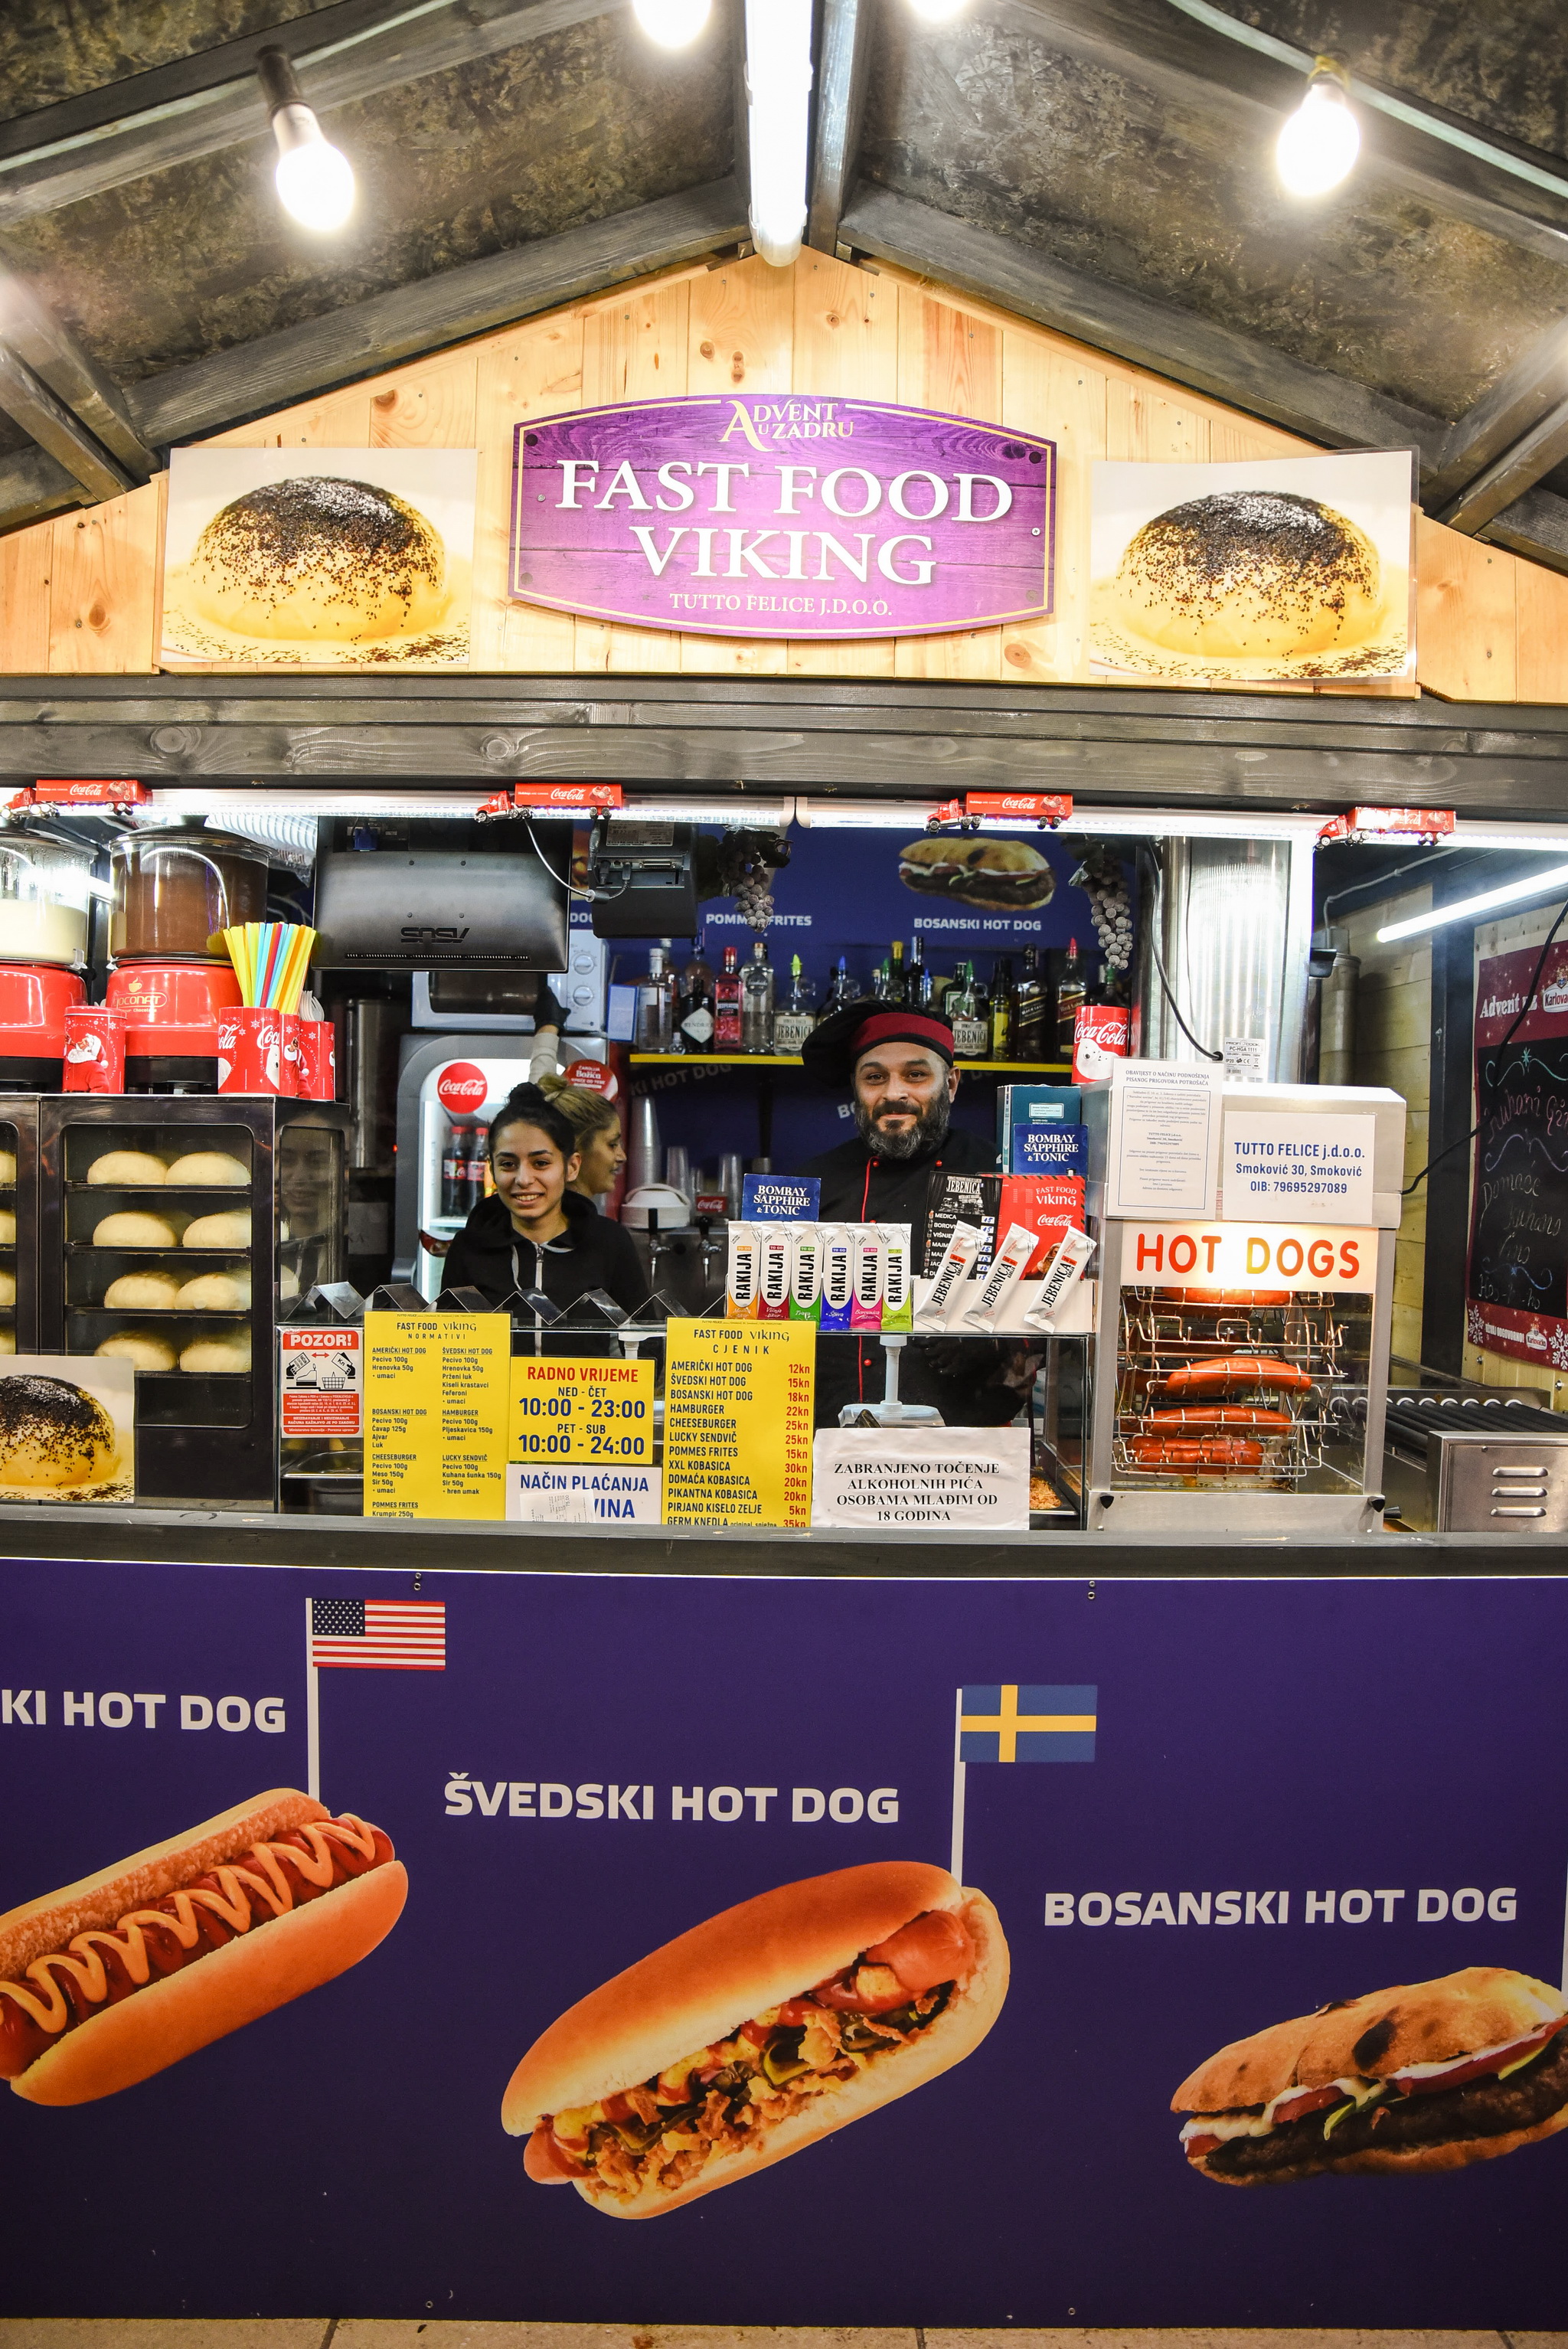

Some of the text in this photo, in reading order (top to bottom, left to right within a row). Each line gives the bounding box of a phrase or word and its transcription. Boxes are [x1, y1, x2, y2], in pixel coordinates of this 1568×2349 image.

[772, 422, 854, 439] ZADRU
[554, 459, 1013, 523] FAST FOOD
[629, 526, 937, 586] VIKING
[670, 593, 893, 616] TUTTO FELICE J.D.O.O.
[768, 915, 812, 926] FRITES
[914, 918, 1041, 931] BOSANSKI HOT DOG
[1480, 993, 1519, 1018] Advent
[1075, 1021, 1128, 1046] Coca-Cola
[439, 1079, 486, 1096] Coca-Cola
[1027, 1135, 1075, 1143] BOMBAY
[1024, 1144, 1078, 1152] SAPPHIRE
[1234, 1142, 1365, 1160] TUTTO FELICE j.d.o.o.
[1236, 1163, 1362, 1176] Smoković 30, Smoković
[758, 1185, 807, 1196] BOMBAY
[946, 1180, 982, 1194] JEBENICA
[1056, 1186, 1076, 1194] FOOD
[1250, 1181, 1347, 1193] OIB: 79695297089
[753, 1194, 810, 1207] SAPPHIRE
[1136, 1233, 1360, 1279] HOT DOGS
[736, 1253, 752, 1299] RAKIJA
[767, 1253, 783, 1299] RAKIJA
[798, 1253, 815, 1300] RAKIJA
[831, 1254, 847, 1301] RAKIJA
[861, 1254, 877, 1301] RAKIJA
[888, 1256, 902, 1302] RAKIJA
[931, 1261, 959, 1306] JEBENICA
[982, 1262, 1012, 1308] JEBENICA
[1041, 1262, 1071, 1308] JEBENICA
[290, 1334, 351, 1346] POZOR!
[694, 1329, 716, 1338] FAST
[720, 1330, 742, 1339] FOOD
[714, 1344, 769, 1354] CJENIK
[671, 1360, 810, 1374] AMERIČKI HOT DOG 12kn
[528, 1367, 638, 1382] RADNO VRIJEME
[671, 1374, 809, 1387] ŠVEDSKI HOT DOG 15kn
[558, 1387, 578, 1397] NED
[588, 1386, 606, 1397] ČET
[671, 1390, 809, 1402] BOSANSKI HOT DOG 18kn
[519, 1398, 571, 1416] 10:00
[591, 1400, 645, 1418] 23:00
[671, 1403, 808, 1416] HAMBURGER 22kn
[557, 1424, 576, 1433] PET
[586, 1425, 606, 1434] SUB
[670, 1418, 808, 1430] CHEESEBURGER 25kn
[518, 1435, 570, 1453] 10:00
[591, 1436, 644, 1455] 24:00
[669, 1431, 808, 1445] LUCKY SENDVIČ 25kn
[669, 1446, 808, 1459] POMMES FRITES 15kn
[668, 1460, 807, 1473] XXL KOBASICA 30kn
[834, 1461, 999, 1474] ZABRANJENO TOČENJE
[521, 1472, 648, 1491] NAČIN PLAĆANJA
[668, 1473, 807, 1487] DOMAĆA KOBASICA 20kn
[848, 1477, 983, 1489] ALKOHOLNIH PIĆA
[668, 1488, 806, 1501] PIKANTNA KOBASICA 20kn
[837, 1495, 998, 1505] OSOBAMA MLAĐIM OD
[668, 1502, 805, 1515] PIRJANO KISELO ZELJE 5kn
[668, 1517, 691, 1525] GERM
[694, 1518, 727, 1526] KNEDLA
[878, 1511, 950, 1521] 18 GODINA
[64, 1691, 166, 1728] HOT
[181, 1695, 286, 1733] DOG
[445, 1772, 899, 1824] ŠVEDSKI HOT DOG
[1044, 1887, 1516, 1926] BOSANSKI HOT DOG
